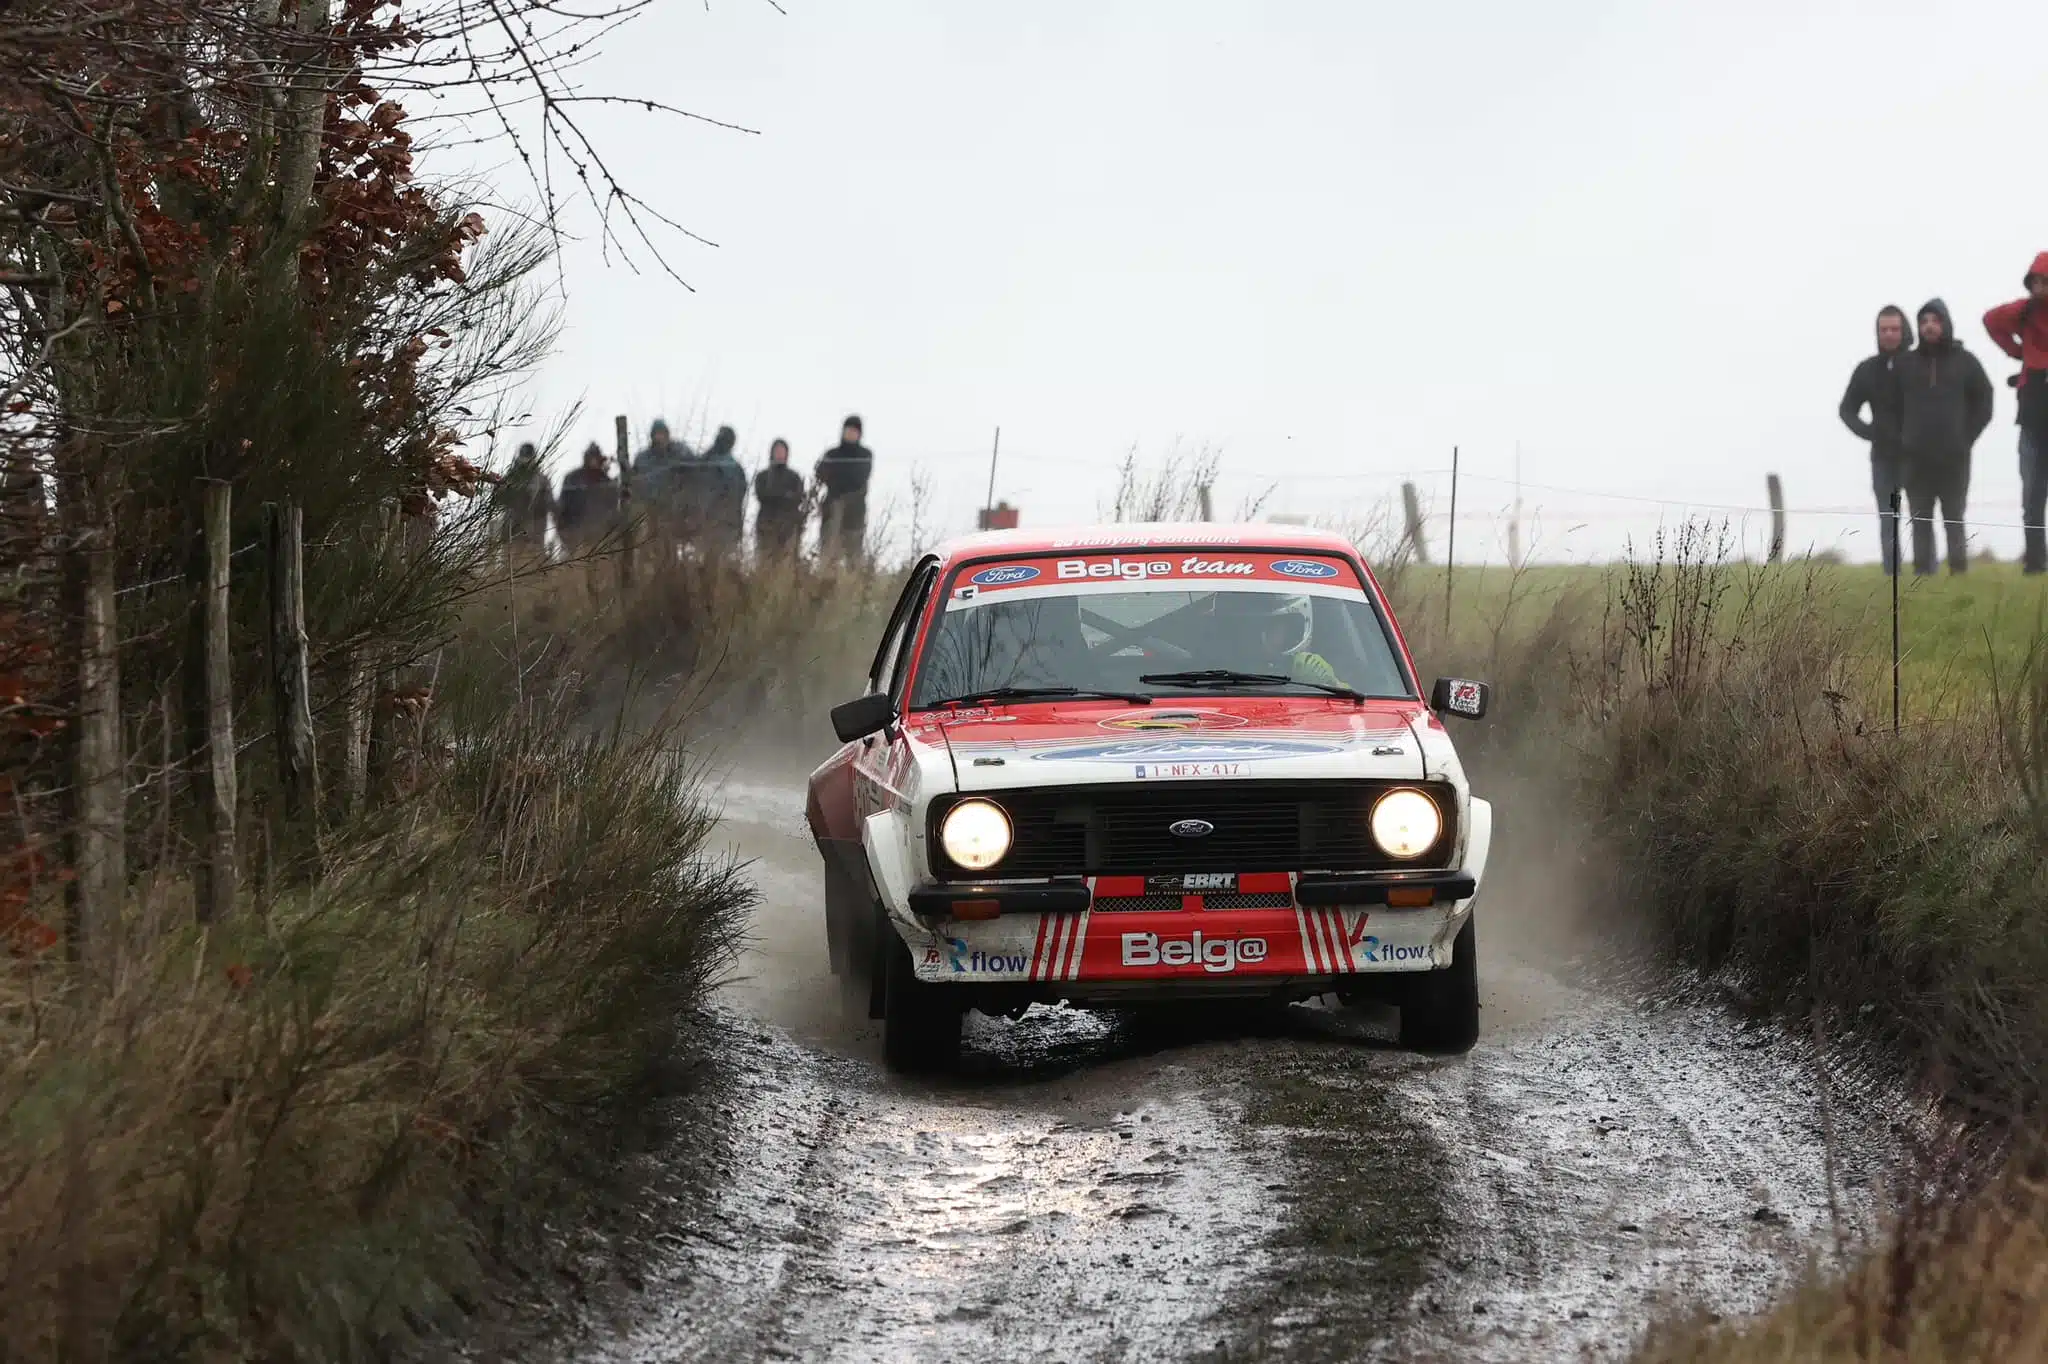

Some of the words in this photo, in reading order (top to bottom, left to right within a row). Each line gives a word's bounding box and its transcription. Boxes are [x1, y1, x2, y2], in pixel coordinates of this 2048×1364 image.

[1181, 557, 1256, 575] team
[1283, 561, 1325, 575] Ford
[985, 567, 1026, 582] Ford
[1183, 873, 1235, 889] EBRT
